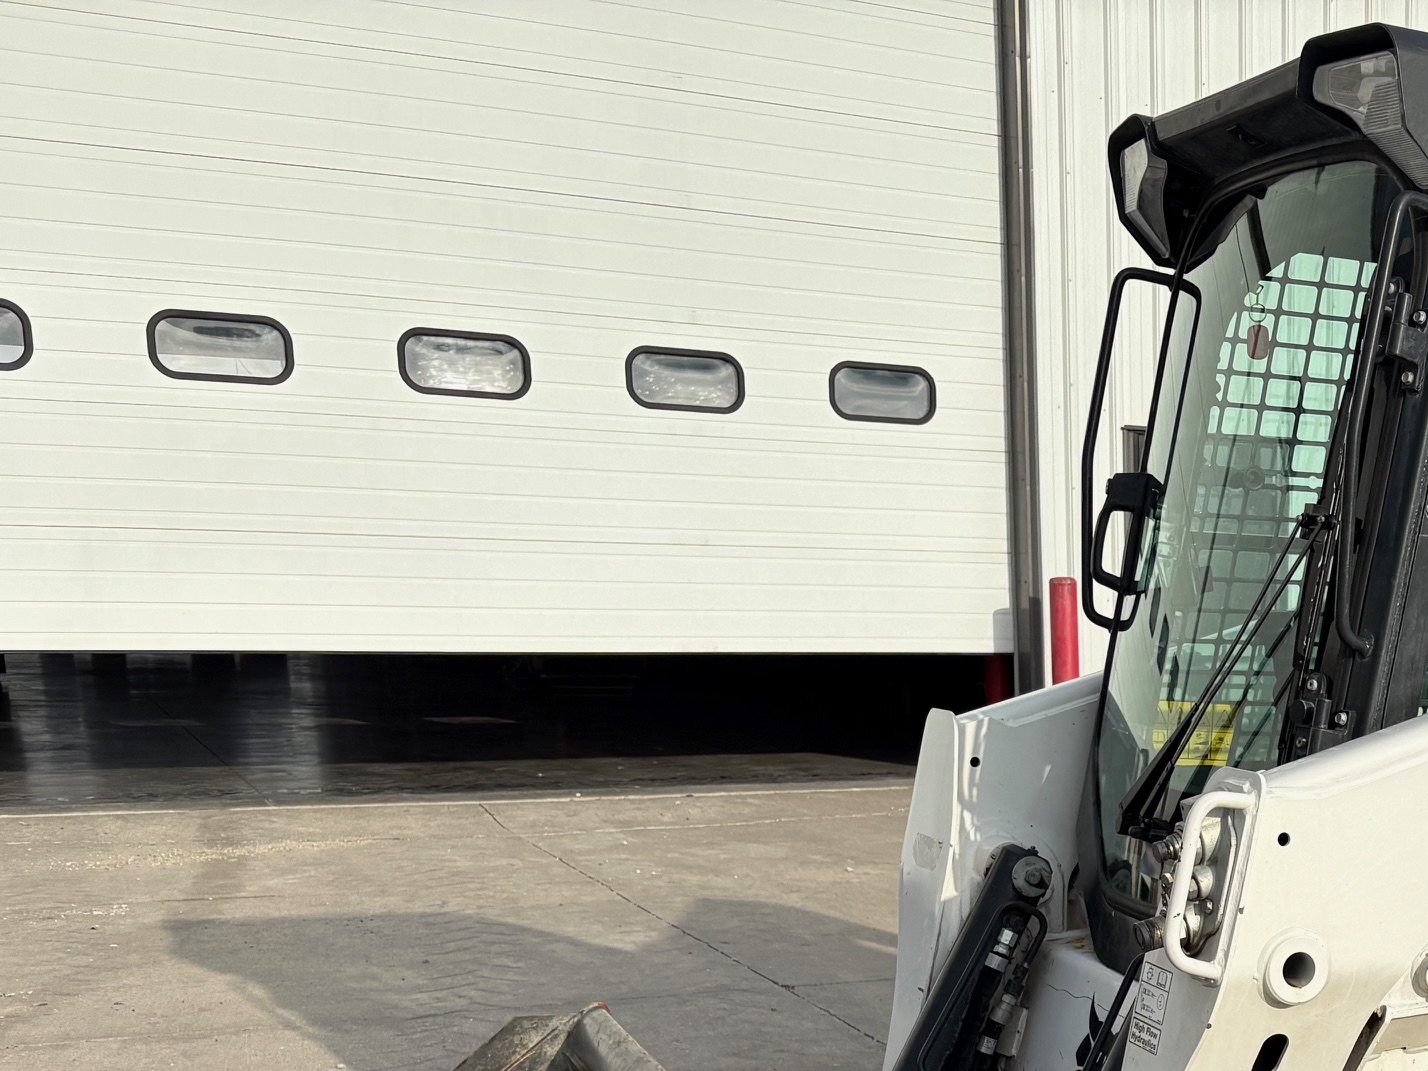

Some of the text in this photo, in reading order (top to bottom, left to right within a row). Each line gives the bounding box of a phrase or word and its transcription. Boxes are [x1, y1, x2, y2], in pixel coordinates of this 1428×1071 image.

[1133, 1022, 1159, 1040] High Flow
[1130, 1031, 1157, 1051] Hydraulics
